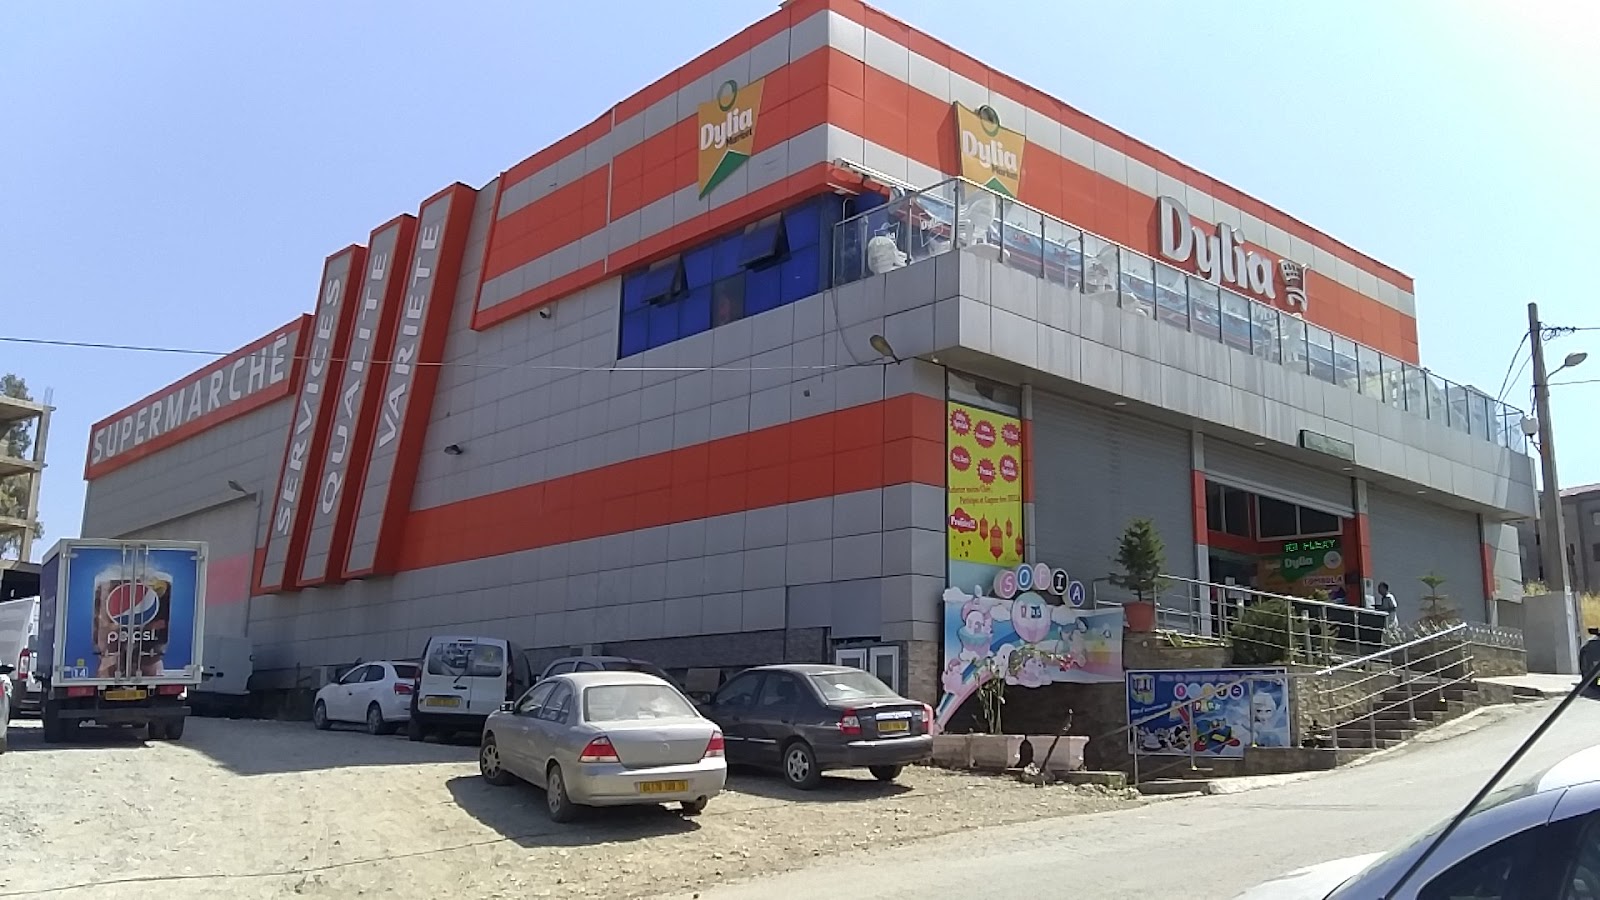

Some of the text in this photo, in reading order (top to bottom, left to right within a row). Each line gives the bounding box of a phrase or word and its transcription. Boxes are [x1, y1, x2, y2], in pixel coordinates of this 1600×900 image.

[700, 107, 753, 150] Dylia
[962, 130, 1018, 172] Dylia
[1158, 196, 1276, 299] Dylia
[322, 252, 388, 514] QUALITE
[379, 224, 439, 448] VARIETE
[92, 332, 288, 465] SUPERMARCHÉ
[278, 277, 341, 536] SERVICES
[1001, 567, 1082, 602] SOFIA
